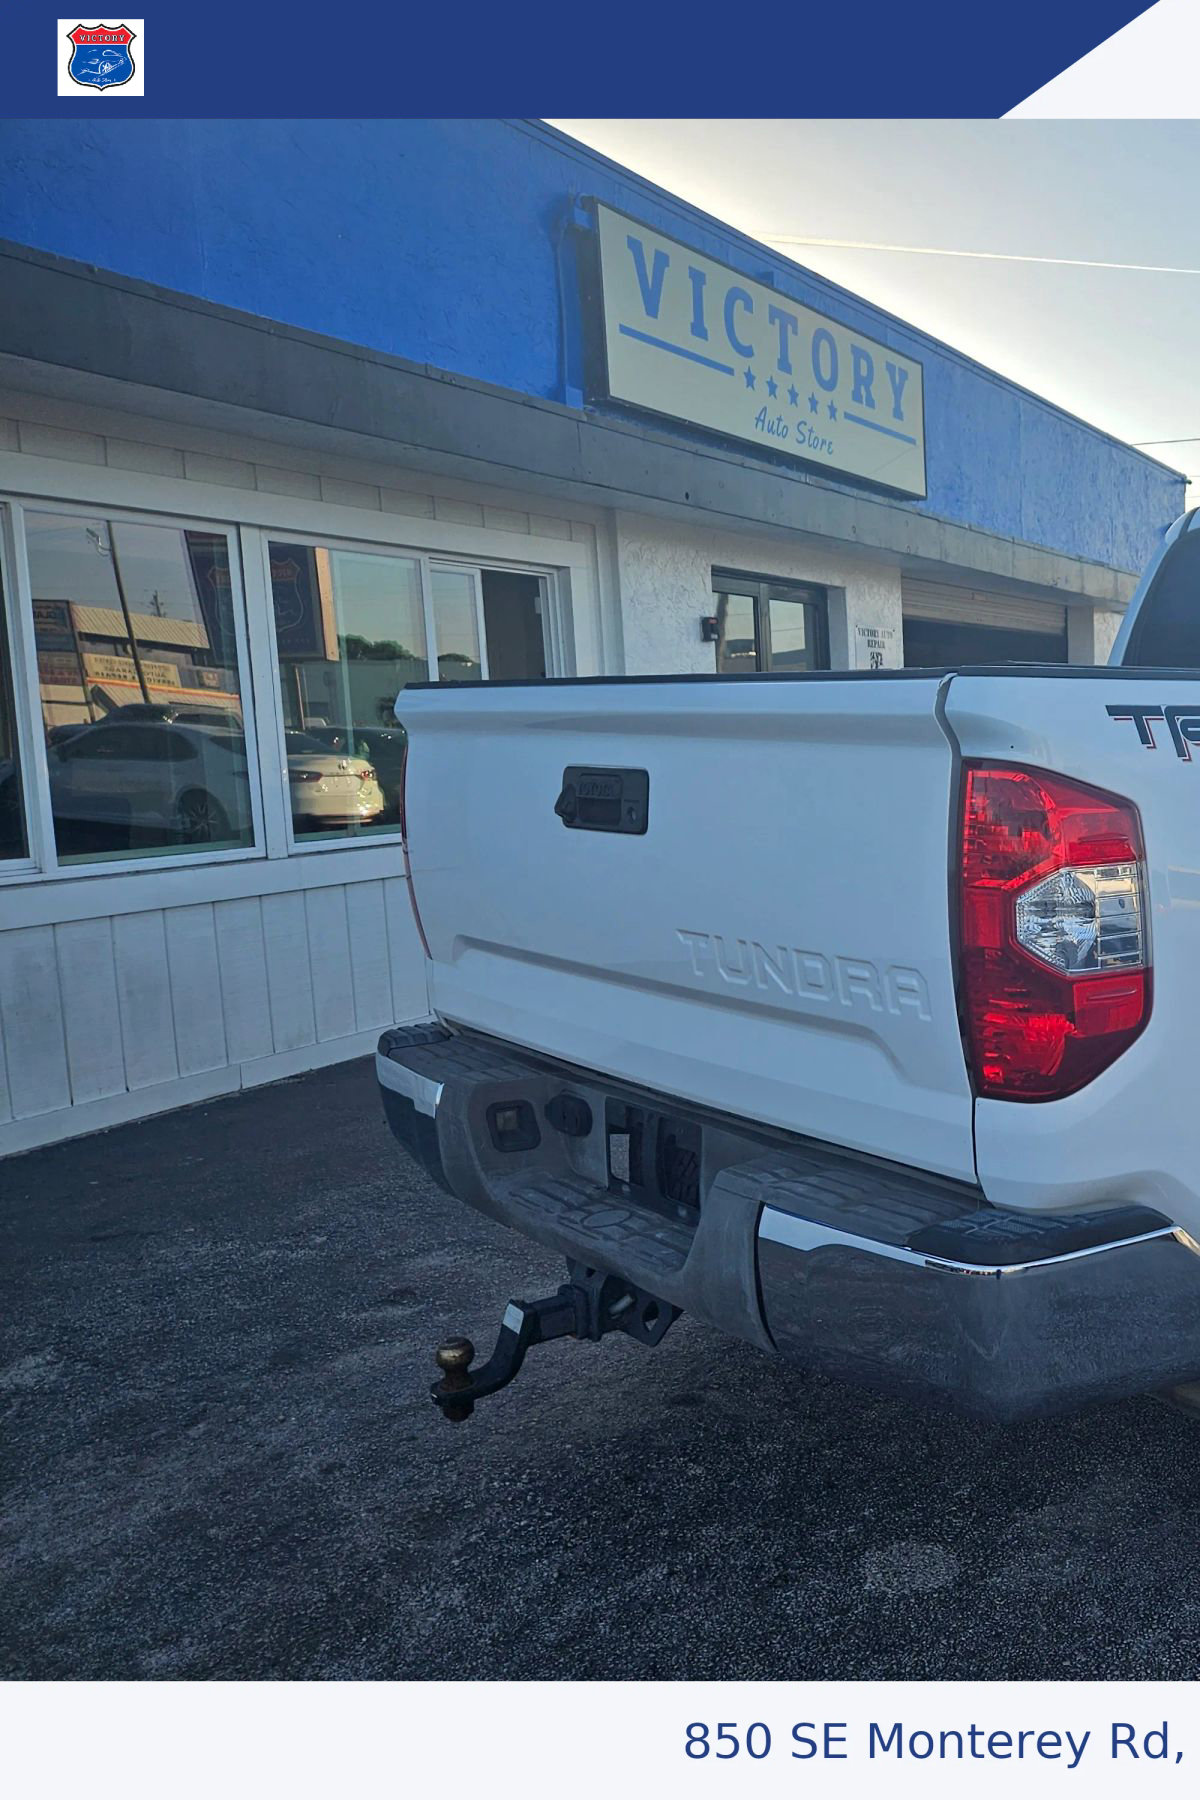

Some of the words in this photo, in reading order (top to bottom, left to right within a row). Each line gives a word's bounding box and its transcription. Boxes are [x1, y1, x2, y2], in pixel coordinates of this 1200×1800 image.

[626, 234, 909, 422] VICTORY
[754, 405, 789, 439] Auto
[795, 420, 834, 456] Store
[675, 928, 932, 1023] TUNDRA
